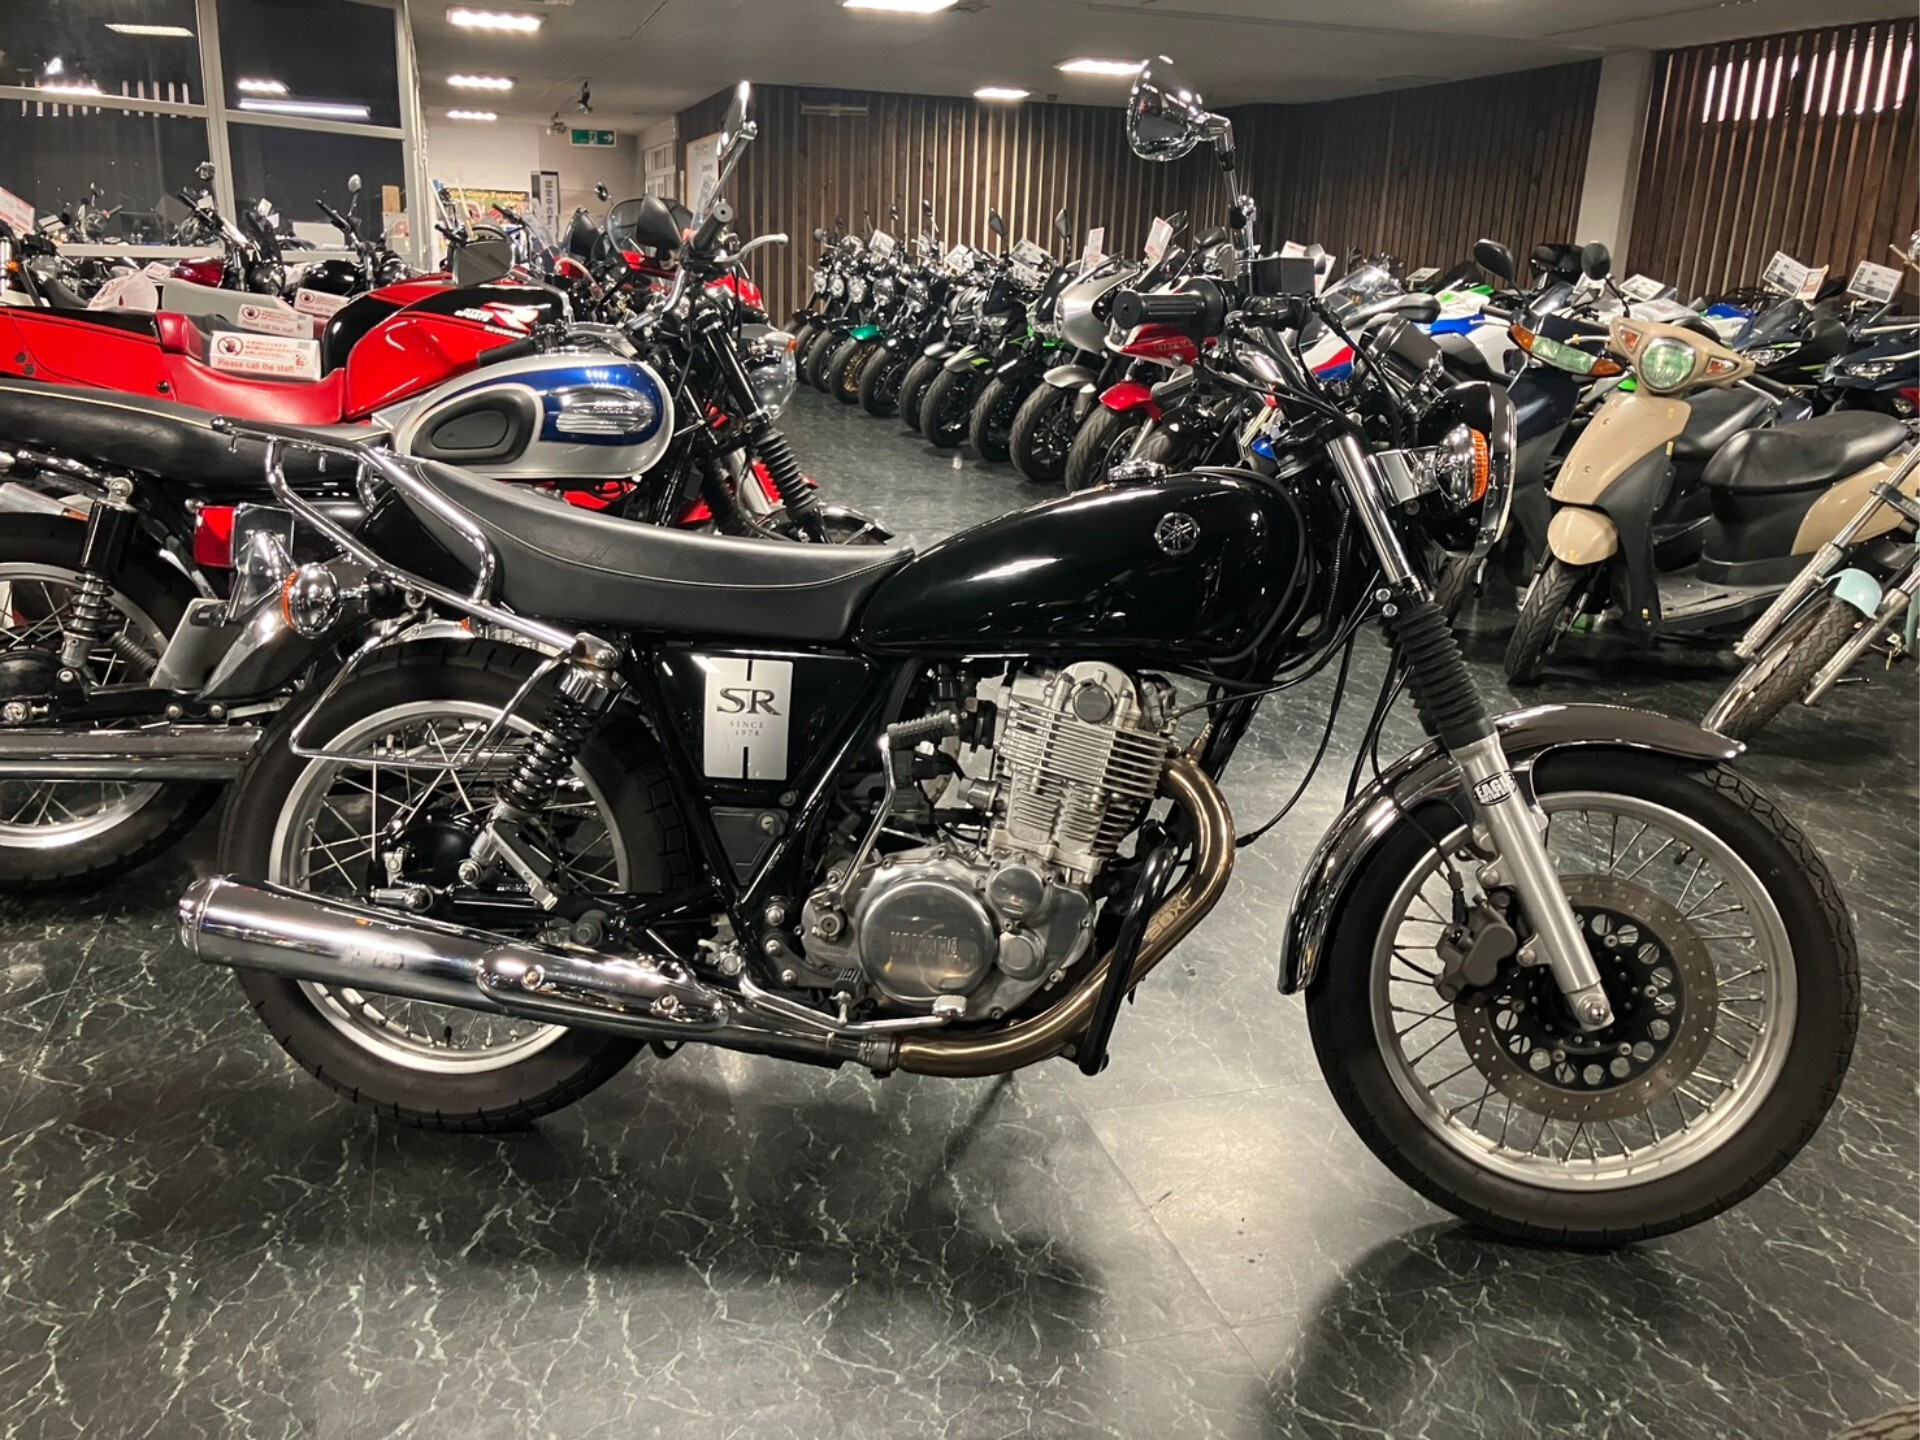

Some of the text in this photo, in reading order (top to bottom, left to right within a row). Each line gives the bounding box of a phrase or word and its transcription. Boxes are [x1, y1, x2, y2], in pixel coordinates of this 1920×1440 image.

[217, 359, 244, 368] Please
[245, 361, 260, 369] call
[262, 363, 275, 371] the
[716, 687, 782, 716] SR
[729, 720, 765, 729] SINCE
[735, 729, 760, 737] 1978
